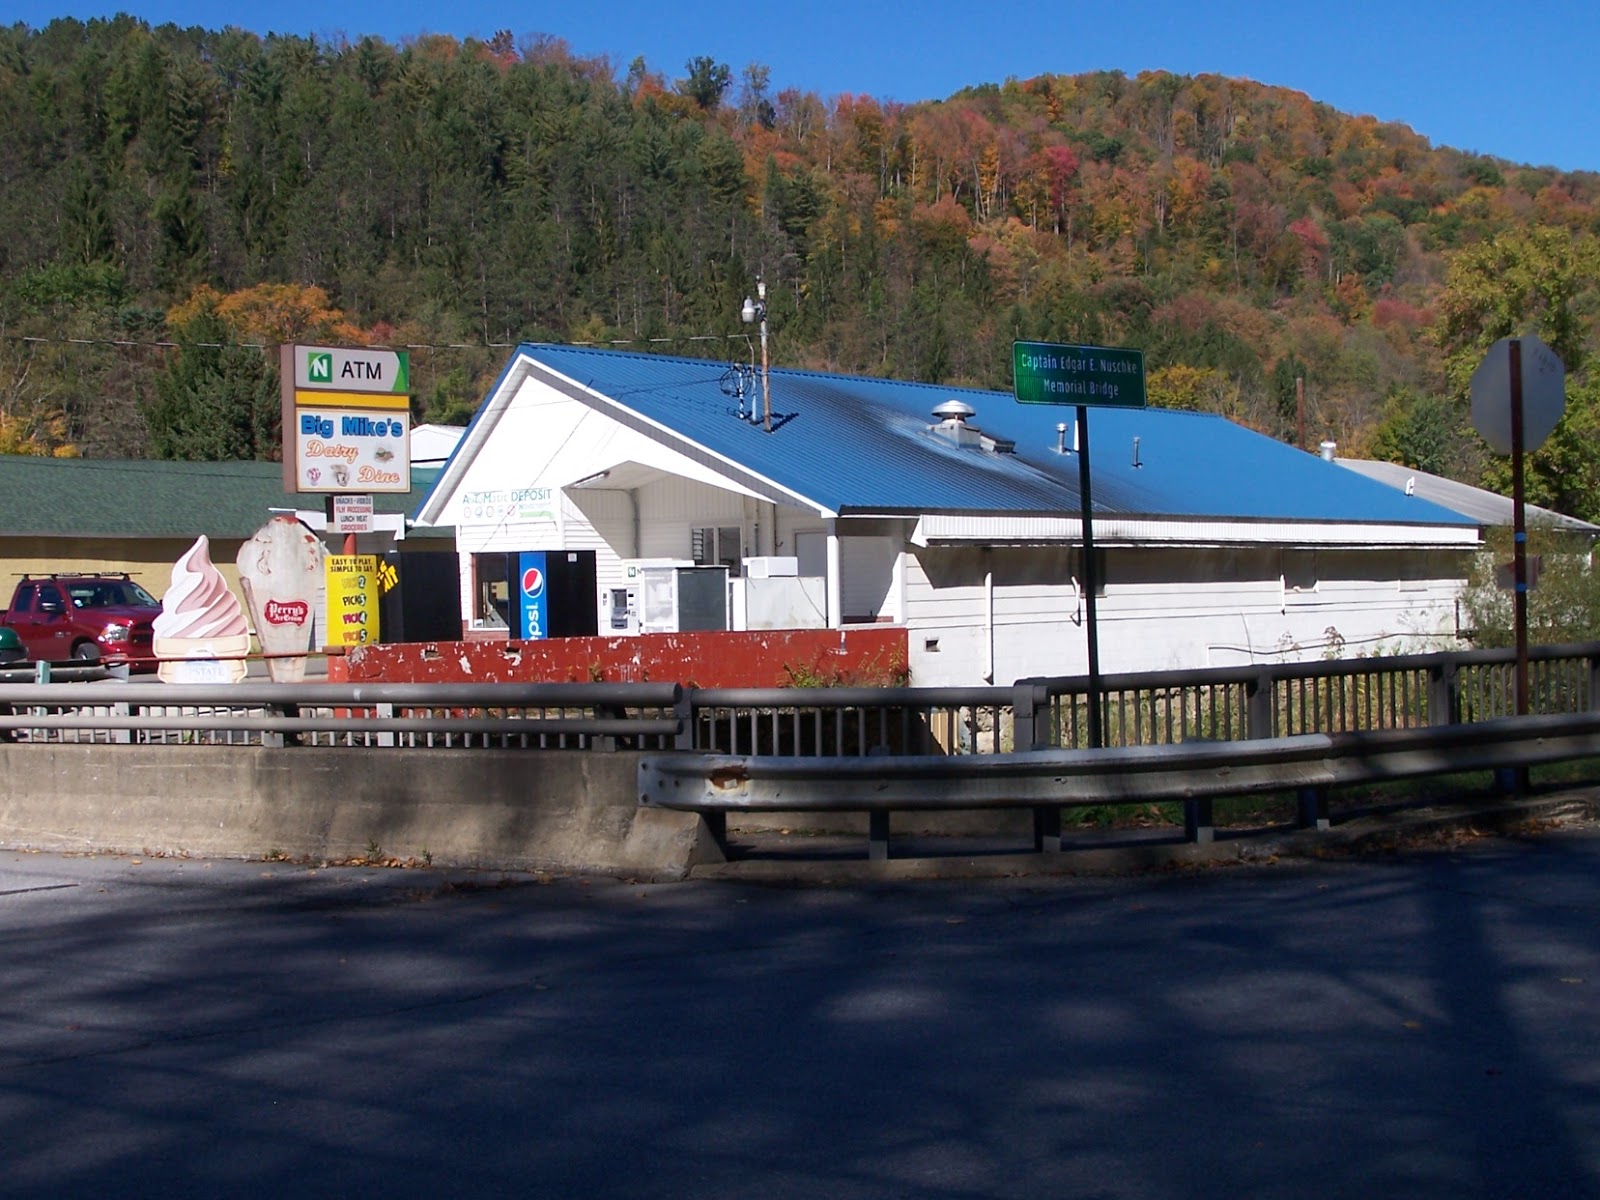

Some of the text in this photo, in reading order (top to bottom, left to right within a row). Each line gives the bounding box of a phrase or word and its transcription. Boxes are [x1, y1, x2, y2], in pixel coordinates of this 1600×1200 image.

[341, 361, 382, 380] ATM
[1021, 354, 1138, 374] Captain Edgar E. Nuschke
[1044, 378, 1119, 399] Memorial Bridge
[301, 415, 403, 438] Big Mike's
[306, 440, 358, 464] Dairy
[358, 466, 400, 483] Dine
[511, 488, 552, 502] DEPOSIT
[269, 603, 304, 617] Perry's
[525, 602, 543, 640] psi
